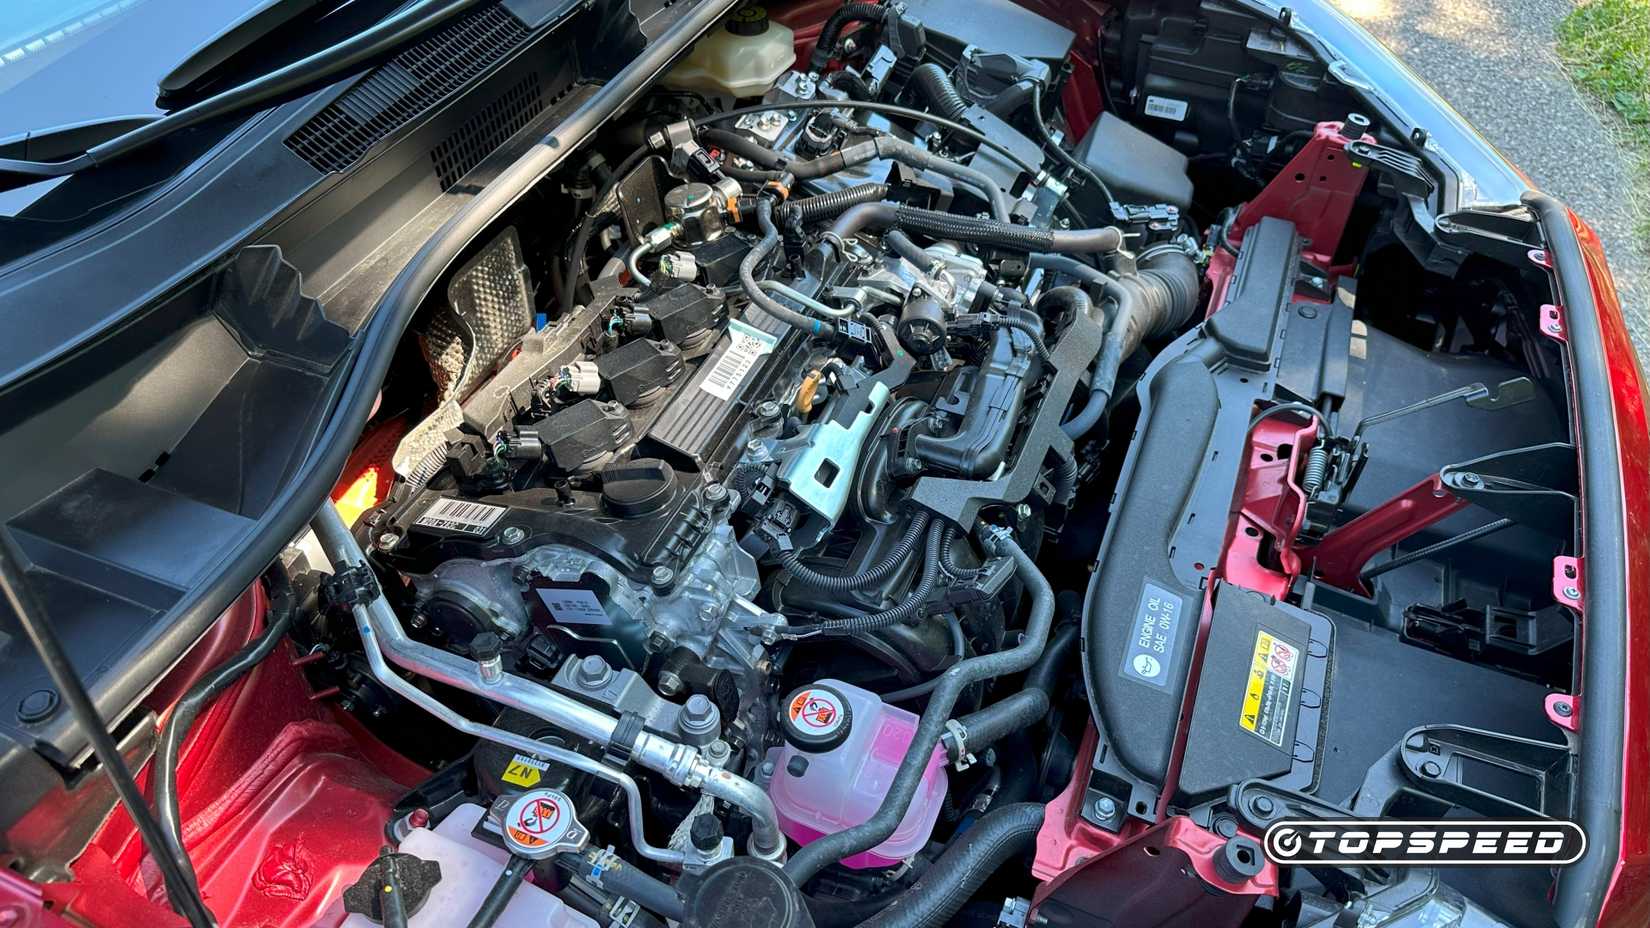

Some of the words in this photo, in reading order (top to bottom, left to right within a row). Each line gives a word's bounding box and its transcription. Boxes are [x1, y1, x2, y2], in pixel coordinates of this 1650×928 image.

[1138, 614, 1156, 648] ENGINE
[1147, 597, 1160, 611] OIL
[1153, 633, 1167, 653] SAE
[1160, 602, 1174, 630] 0W-16
